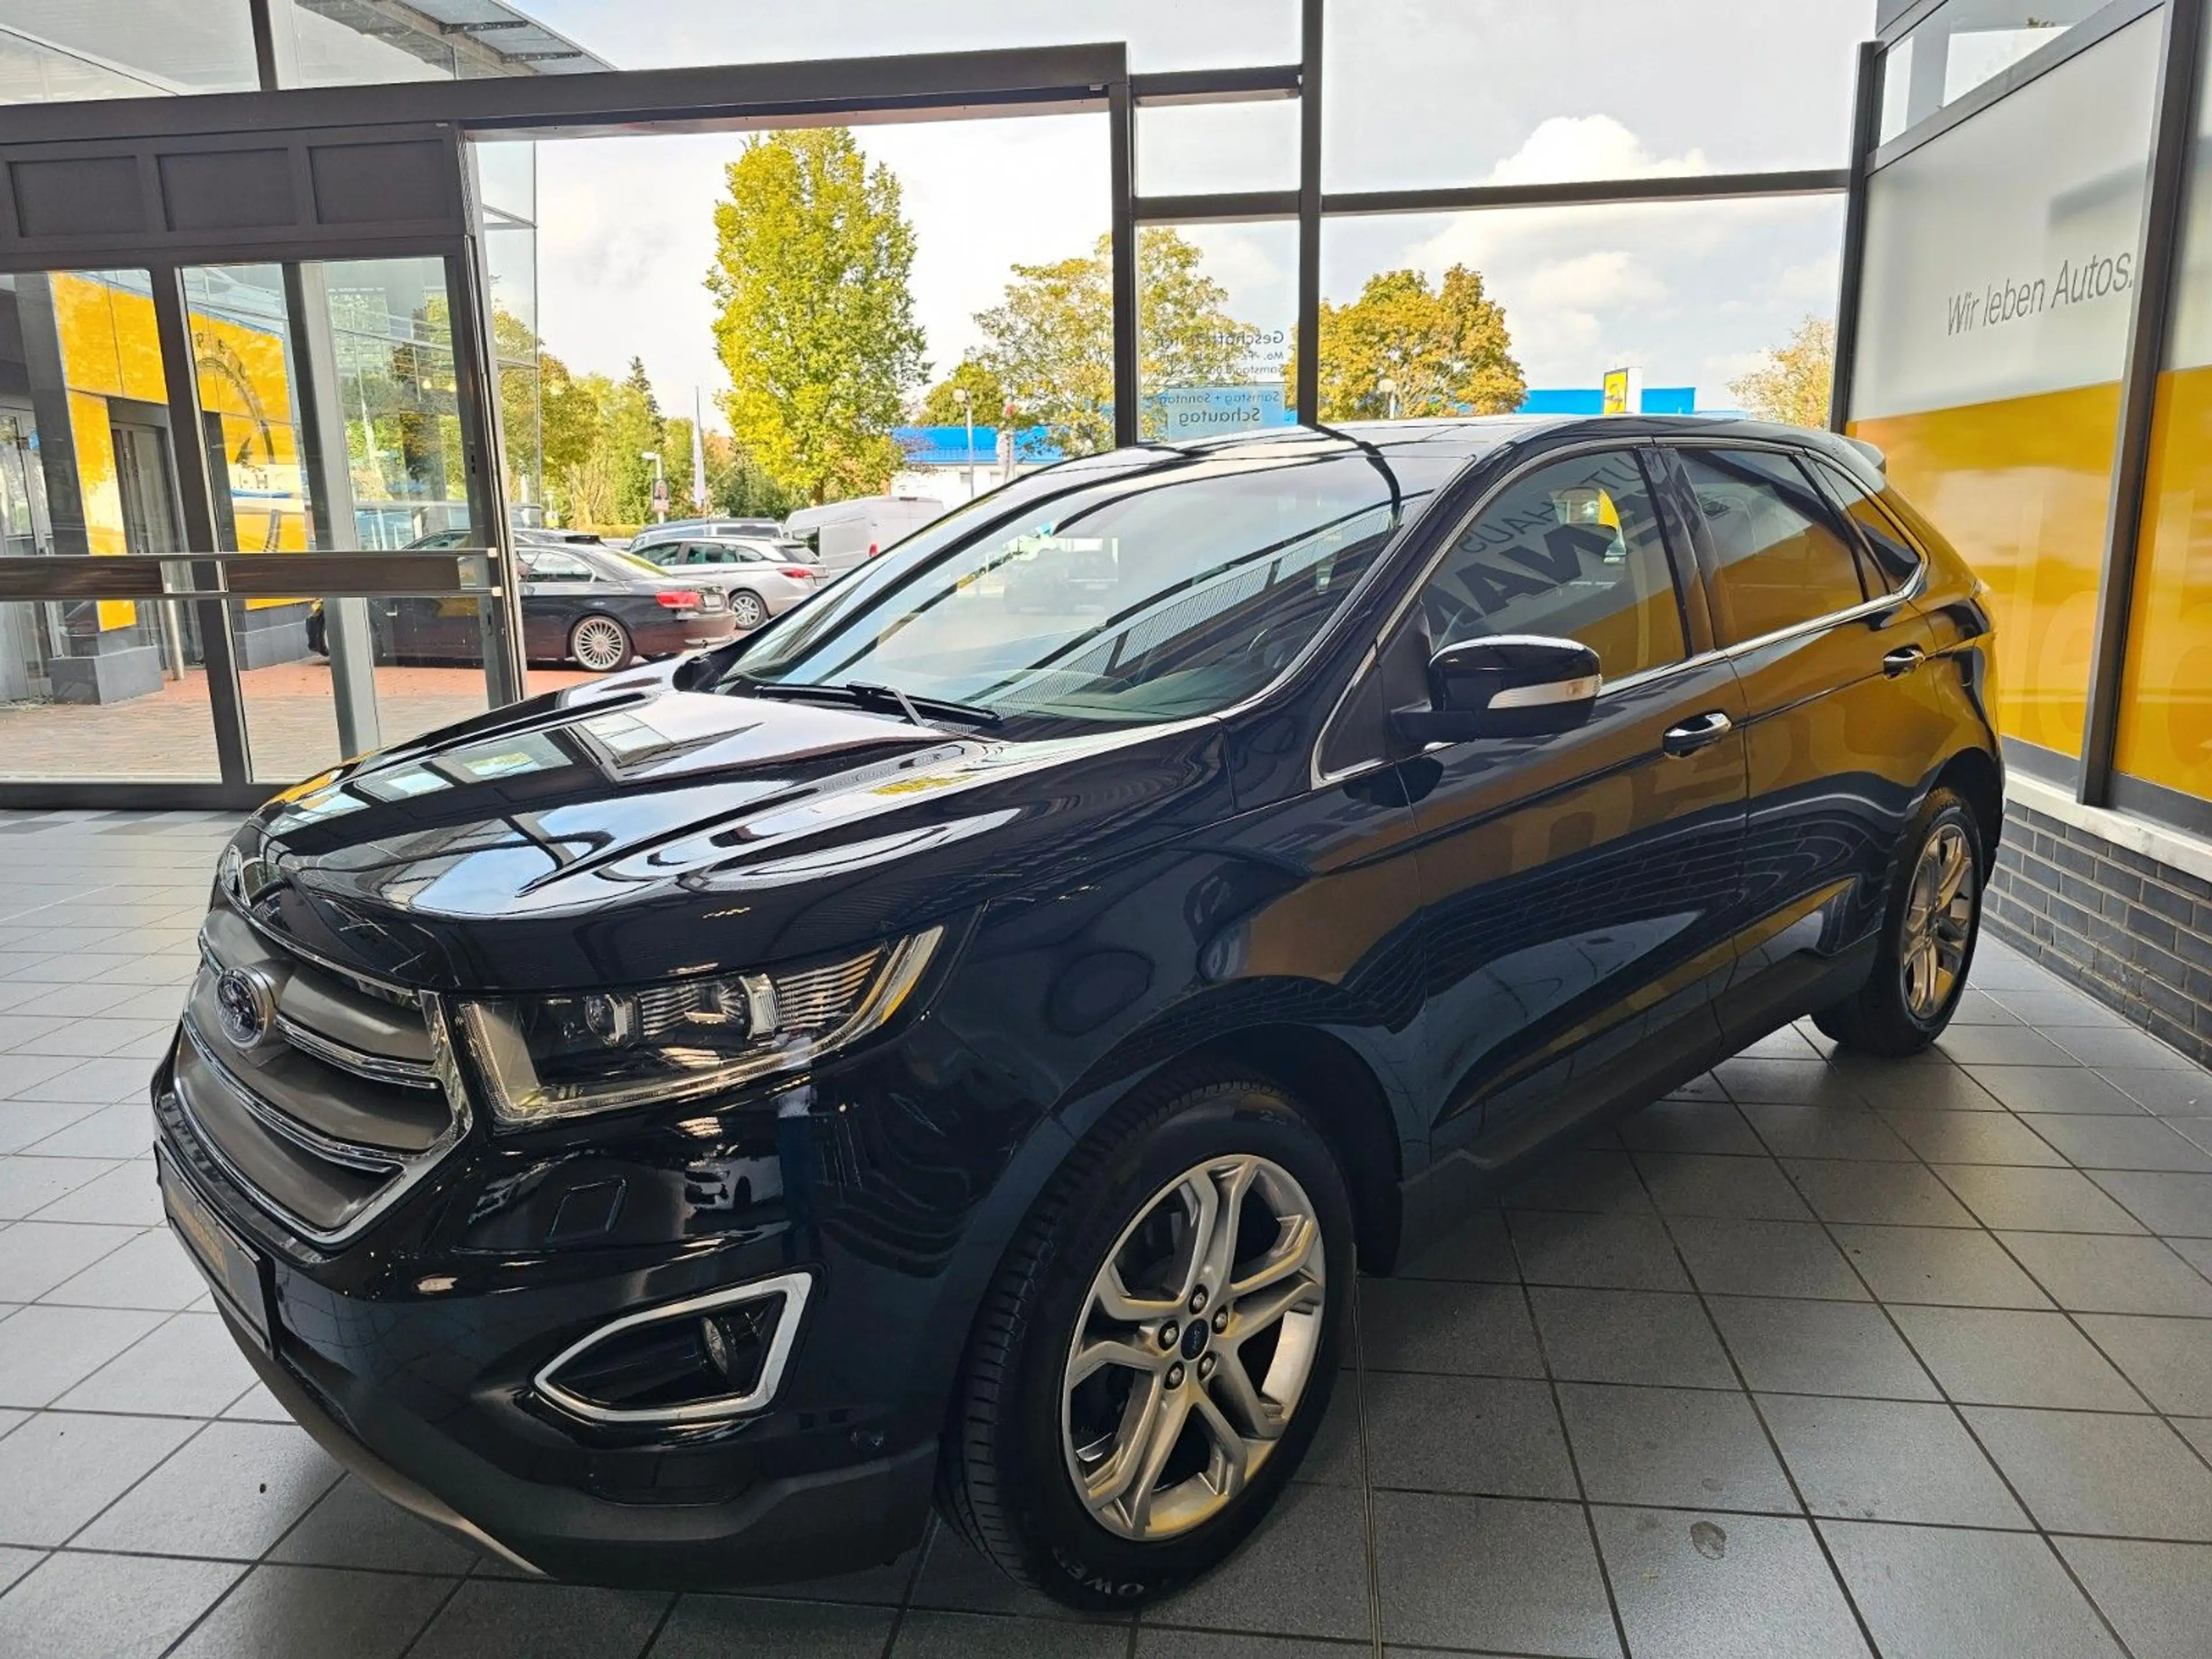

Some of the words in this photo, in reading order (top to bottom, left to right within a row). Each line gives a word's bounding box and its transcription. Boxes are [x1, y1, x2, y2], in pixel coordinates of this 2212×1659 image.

[1947, 291, 1979, 336] Wir
[1983, 277, 2046, 327] leben
[2051, 252, 2134, 309] Autos.
